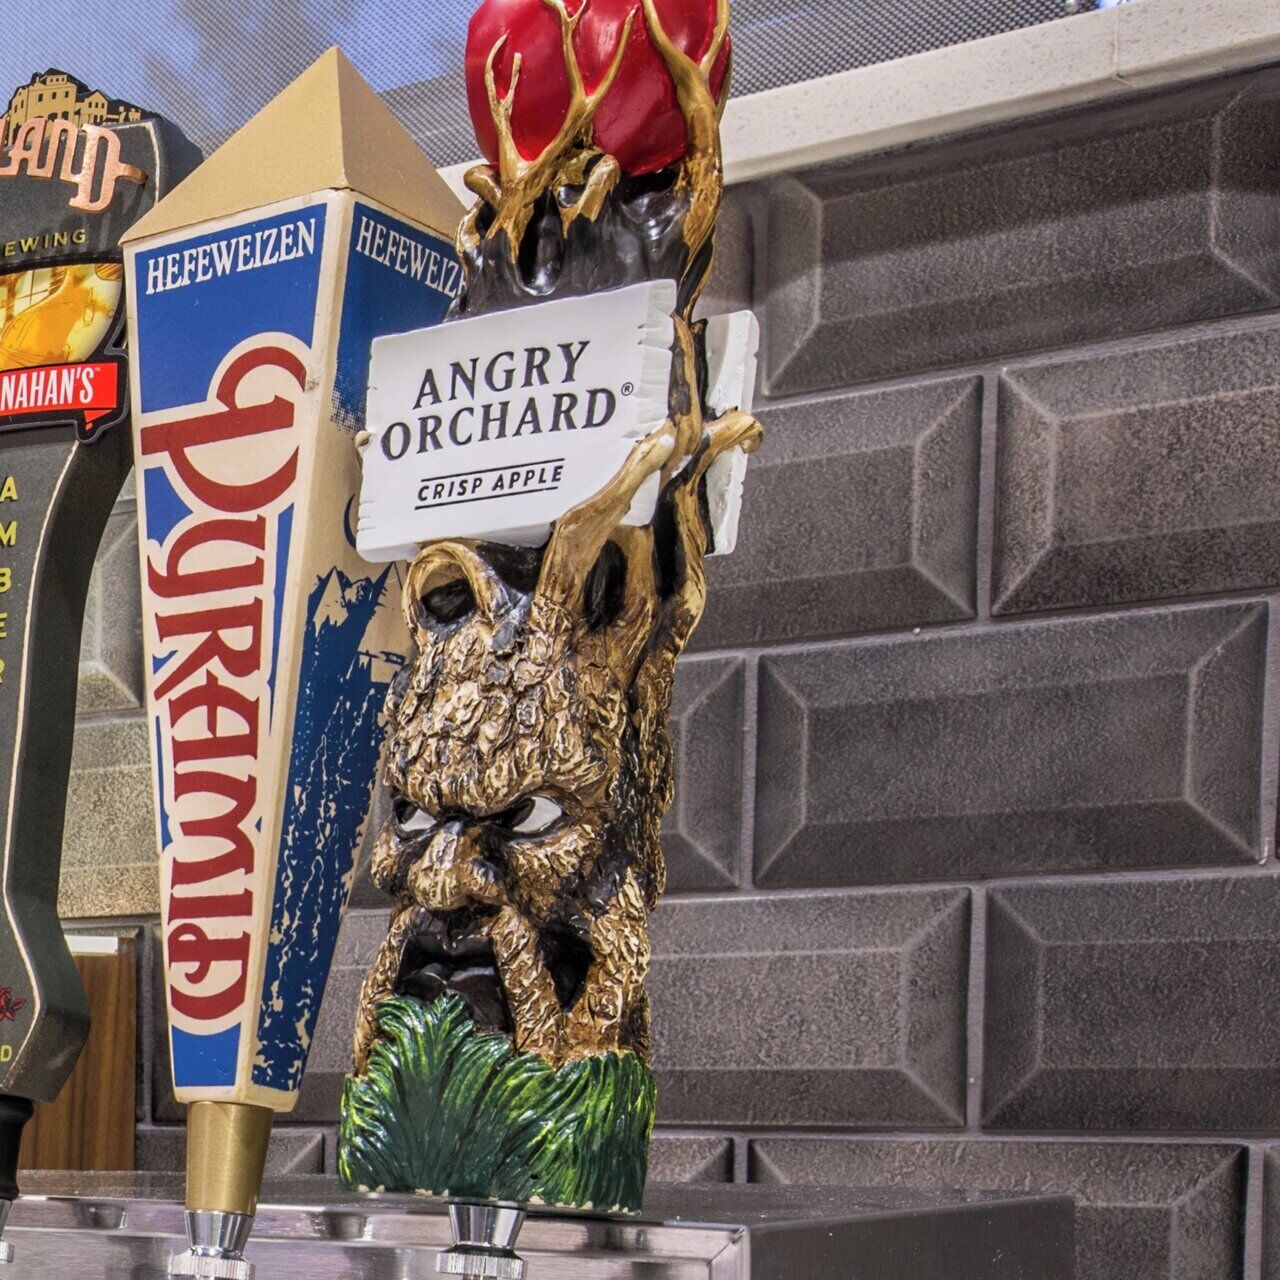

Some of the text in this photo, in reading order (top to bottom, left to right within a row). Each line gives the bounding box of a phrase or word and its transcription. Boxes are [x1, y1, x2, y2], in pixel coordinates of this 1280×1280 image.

[145, 217, 317, 296] HEFEWEIZEN
[411, 340, 591, 410] ANGRY
[380, 387, 617, 461] ORCHARD
[417, 465, 564, 503] CRISP APPLE
